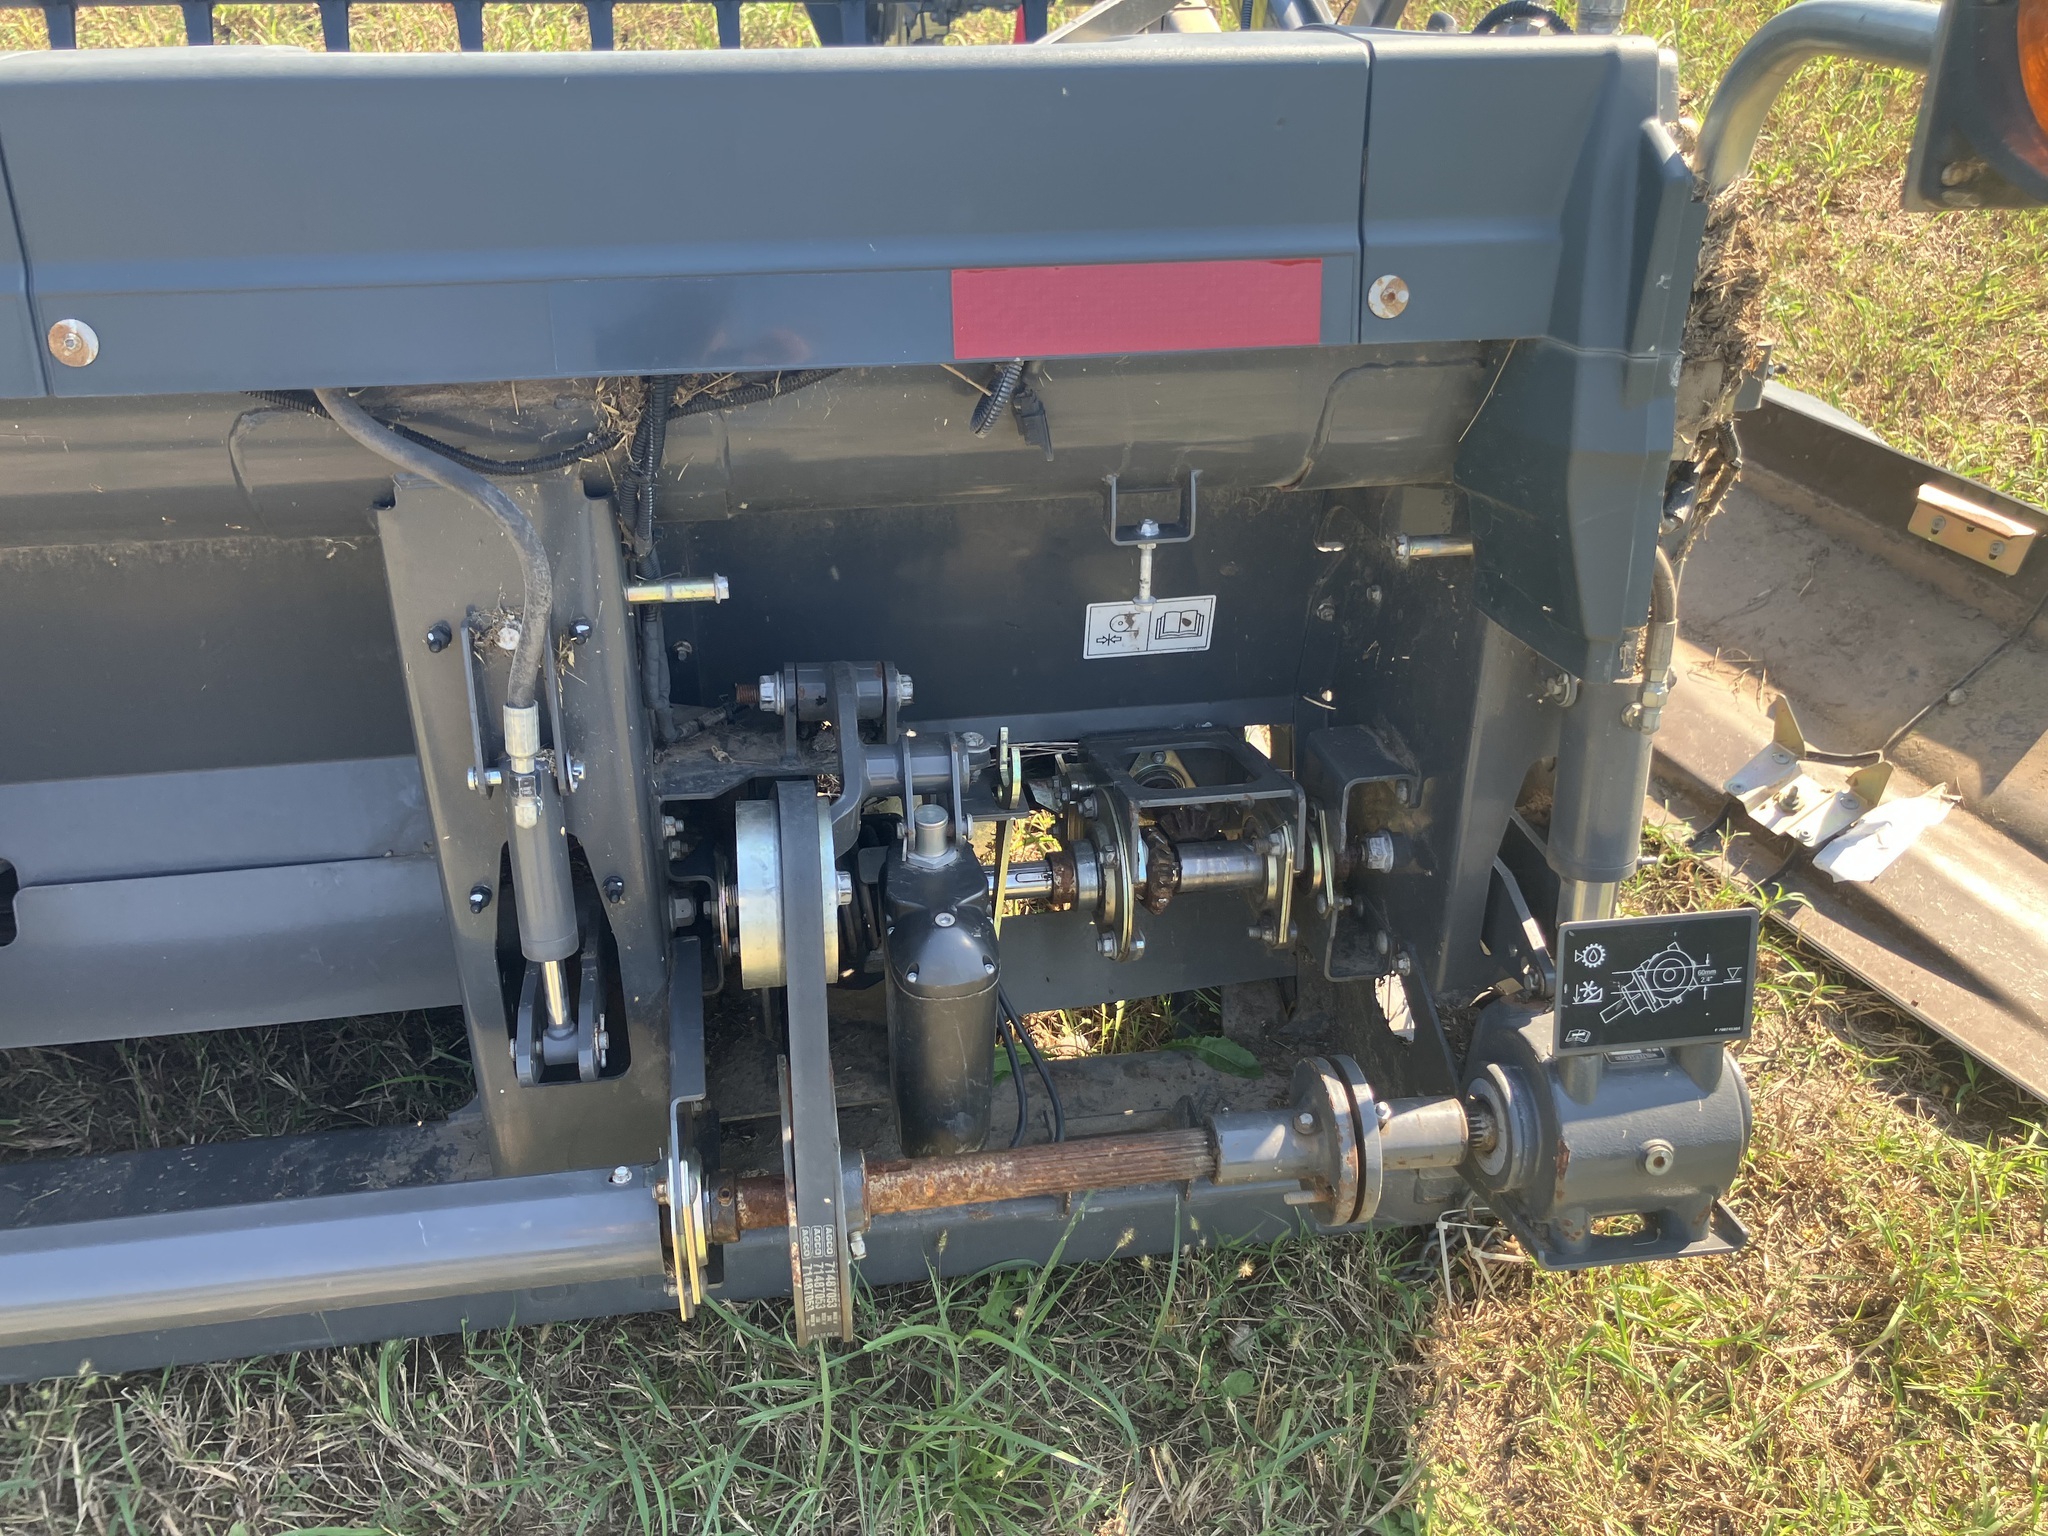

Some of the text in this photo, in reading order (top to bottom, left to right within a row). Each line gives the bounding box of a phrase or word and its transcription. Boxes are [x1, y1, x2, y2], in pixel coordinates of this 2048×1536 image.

[801, 1229, 811, 1257] AGCO
[813, 1228, 822, 1256] AGCO
[825, 1227, 834, 1254] AGCO
[802, 1264, 815, 1312] 71487053
[813, 1262, 826, 1310] 71487053
[825, 1262, 838, 1309] 71487053
